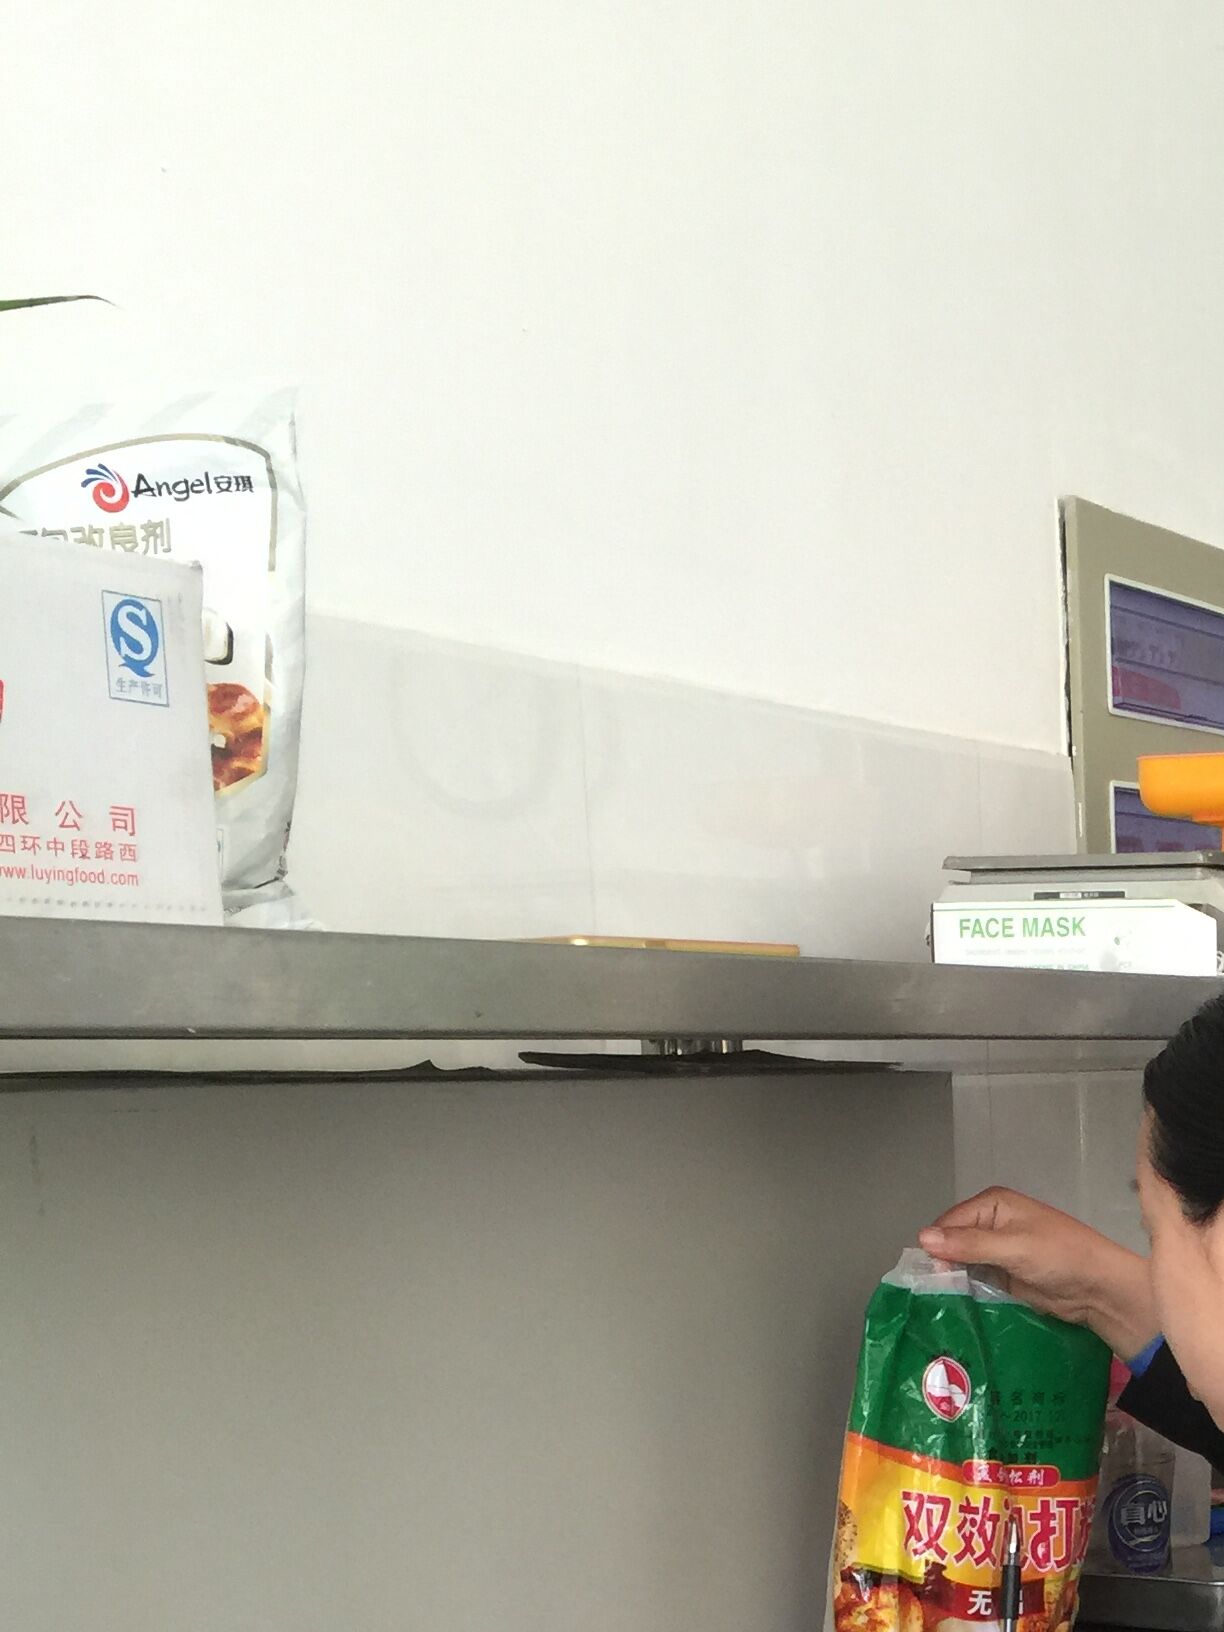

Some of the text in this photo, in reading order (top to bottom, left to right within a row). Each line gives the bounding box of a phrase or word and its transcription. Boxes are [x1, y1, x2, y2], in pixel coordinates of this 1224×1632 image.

[131, 471, 212, 501] Angel
[18, 518, 172, 555] 改良剂
[0, 864, 140, 886] ww.luyingfood.com
[959, 916, 1087, 938] FACE MASK
